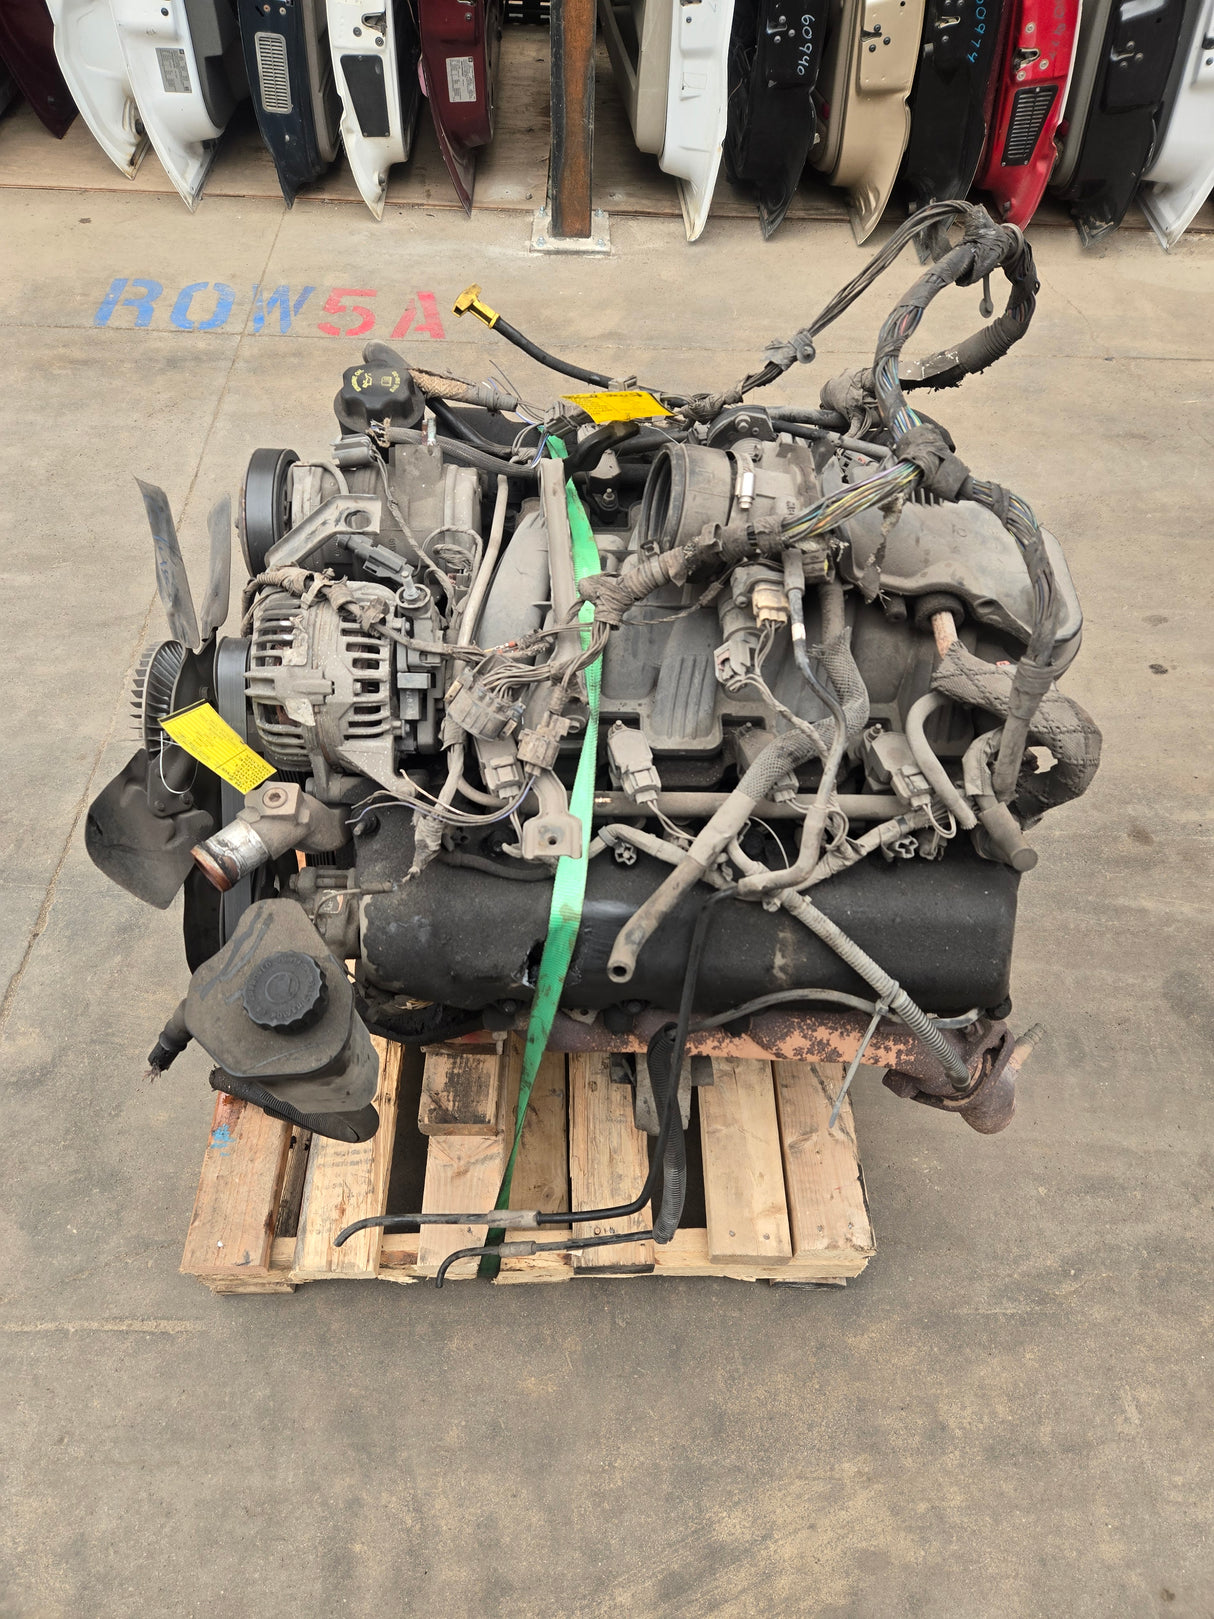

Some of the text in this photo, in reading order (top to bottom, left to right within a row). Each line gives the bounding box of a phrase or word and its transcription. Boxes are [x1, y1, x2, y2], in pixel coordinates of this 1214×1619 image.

[797, 14, 815, 76] 60940
[93, 278, 446, 339] ROW 5A
